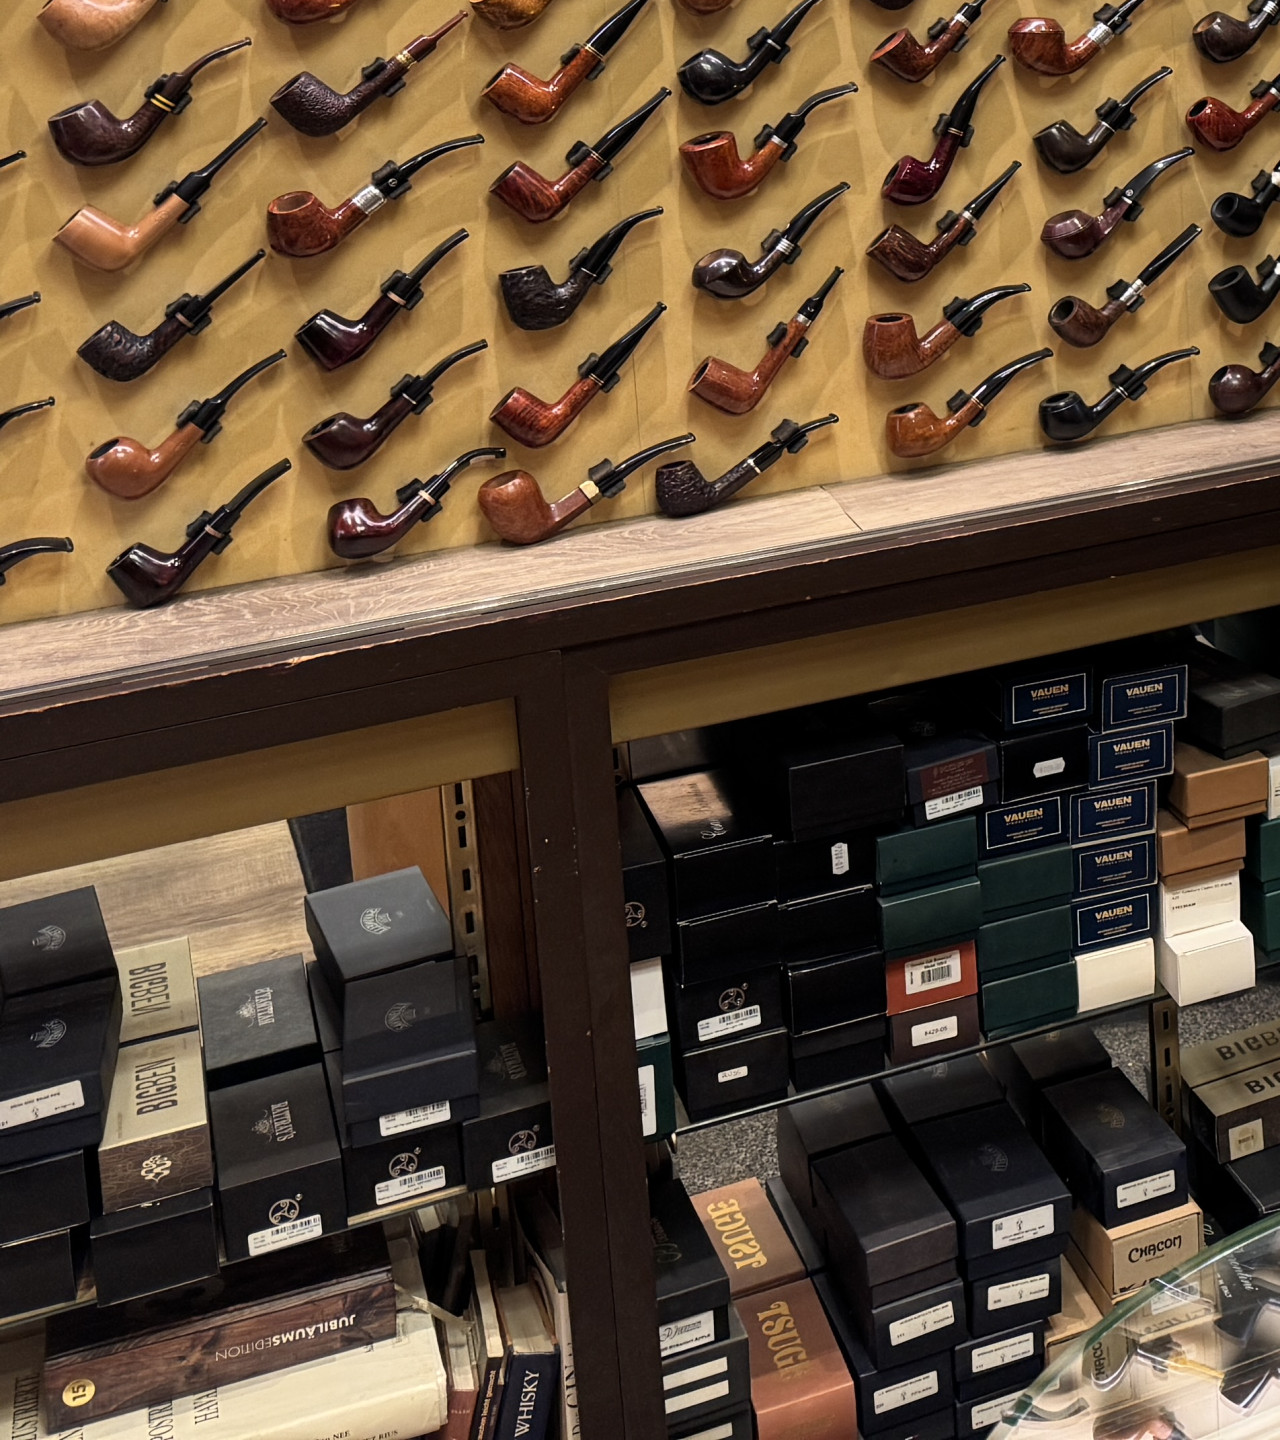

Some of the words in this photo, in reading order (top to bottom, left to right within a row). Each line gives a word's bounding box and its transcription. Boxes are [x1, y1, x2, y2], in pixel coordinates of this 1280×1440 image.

[1030, 684, 1069, 698] VAUEN
[1126, 683, 1163, 697] VAUEN
[1113, 738, 1151, 752] VAUEN
[1093, 795, 1132, 809] VAUEN
[1003, 807, 1043, 823] VAUEN
[1095, 850, 1133, 864] VAUEN
[1095, 904, 1133, 920] VAUEN
[129, 961, 171, 1017] BIGBEN
[135, 1056, 179, 1117] BIGBEN
[270, 1100, 297, 1142] RATTRAY'S
[706, 1198, 768, 1270] TSUGE
[1127, 1234, 1183, 1264] CHACOM
[215, 1313, 356, 1362] JUBILÄUMSEDITION
[72, 1384, 87, 1402] 15
[514, 1370, 540, 1438] WHISKY
